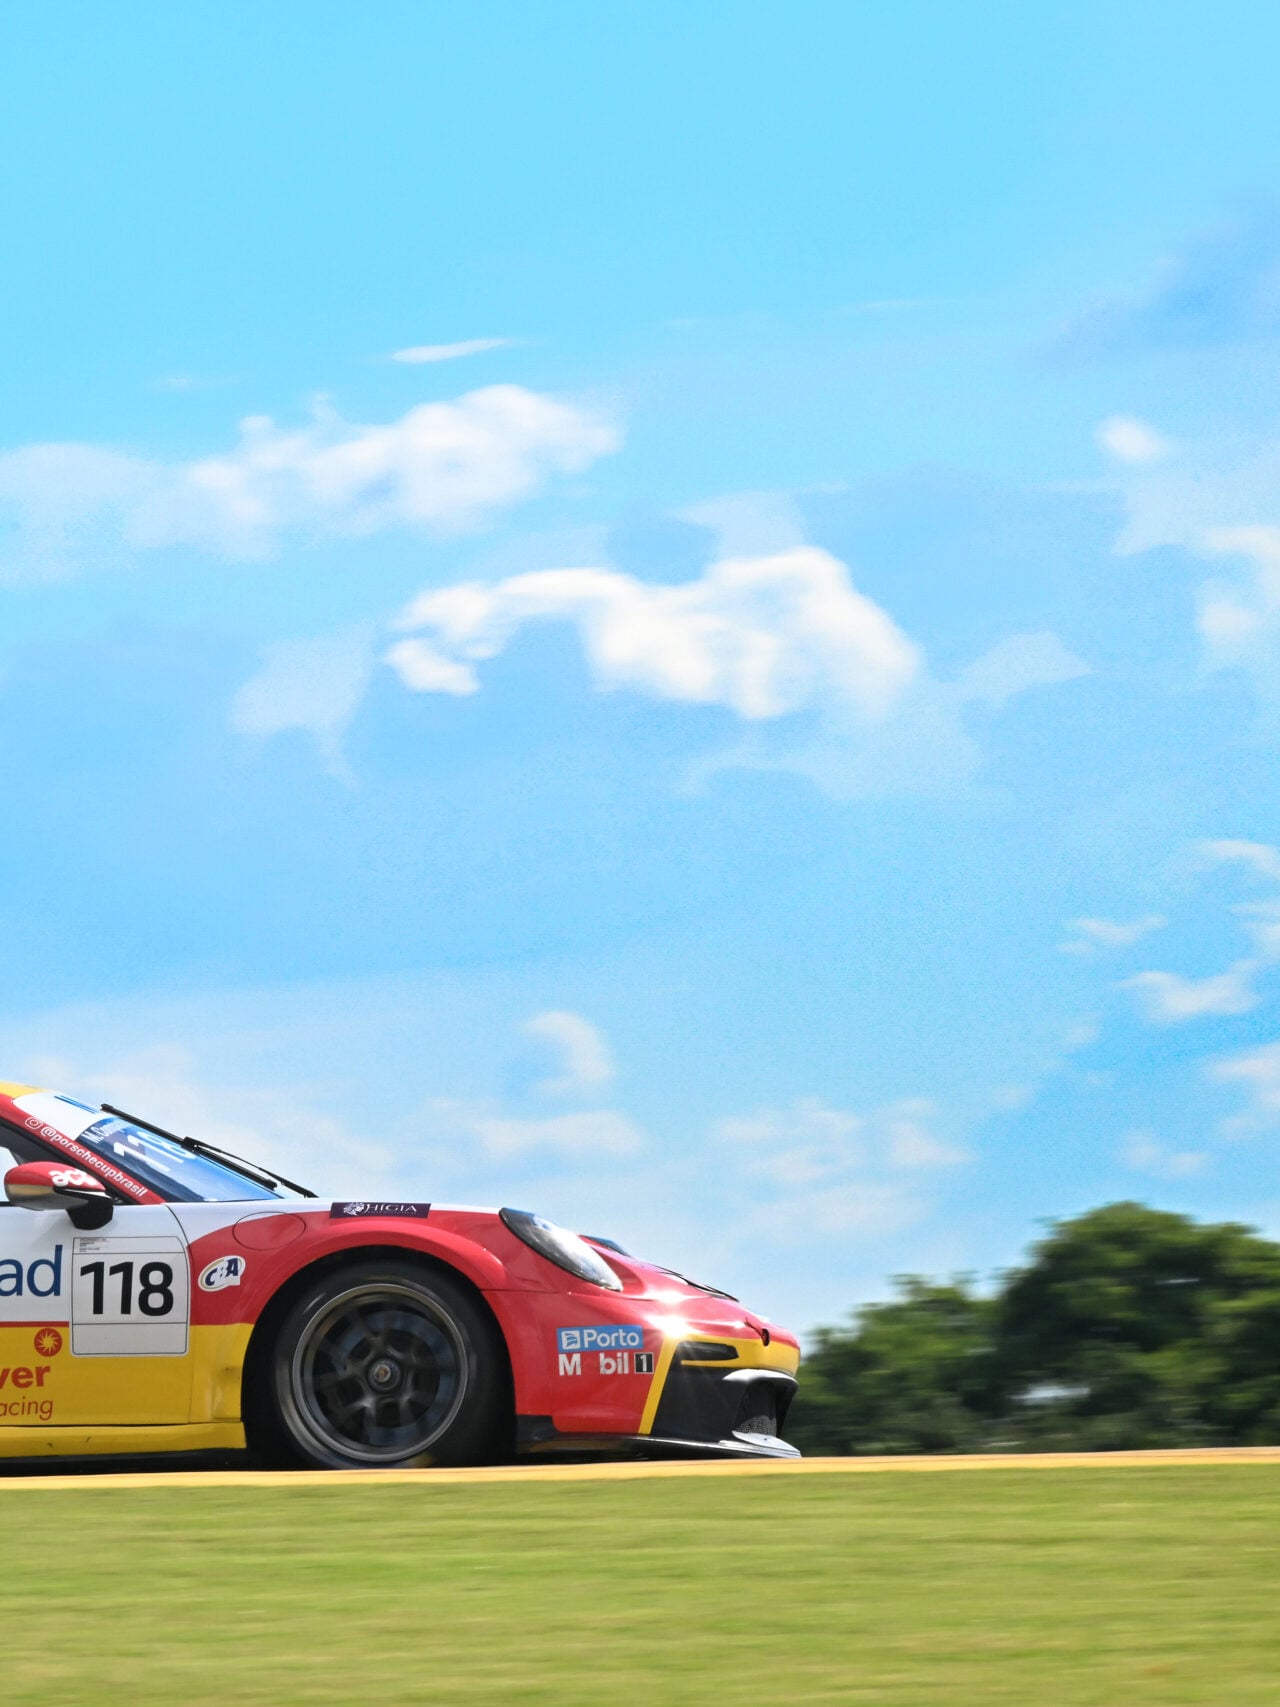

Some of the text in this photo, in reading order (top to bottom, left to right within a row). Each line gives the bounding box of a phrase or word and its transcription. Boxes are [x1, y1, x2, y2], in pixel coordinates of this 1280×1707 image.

[40, 1125, 149, 1197] @porschecupbrasil
[80, 1261, 174, 1317] 118
[583, 1328, 640, 1348] Porto
[558, 1352, 629, 1376] Mbil
